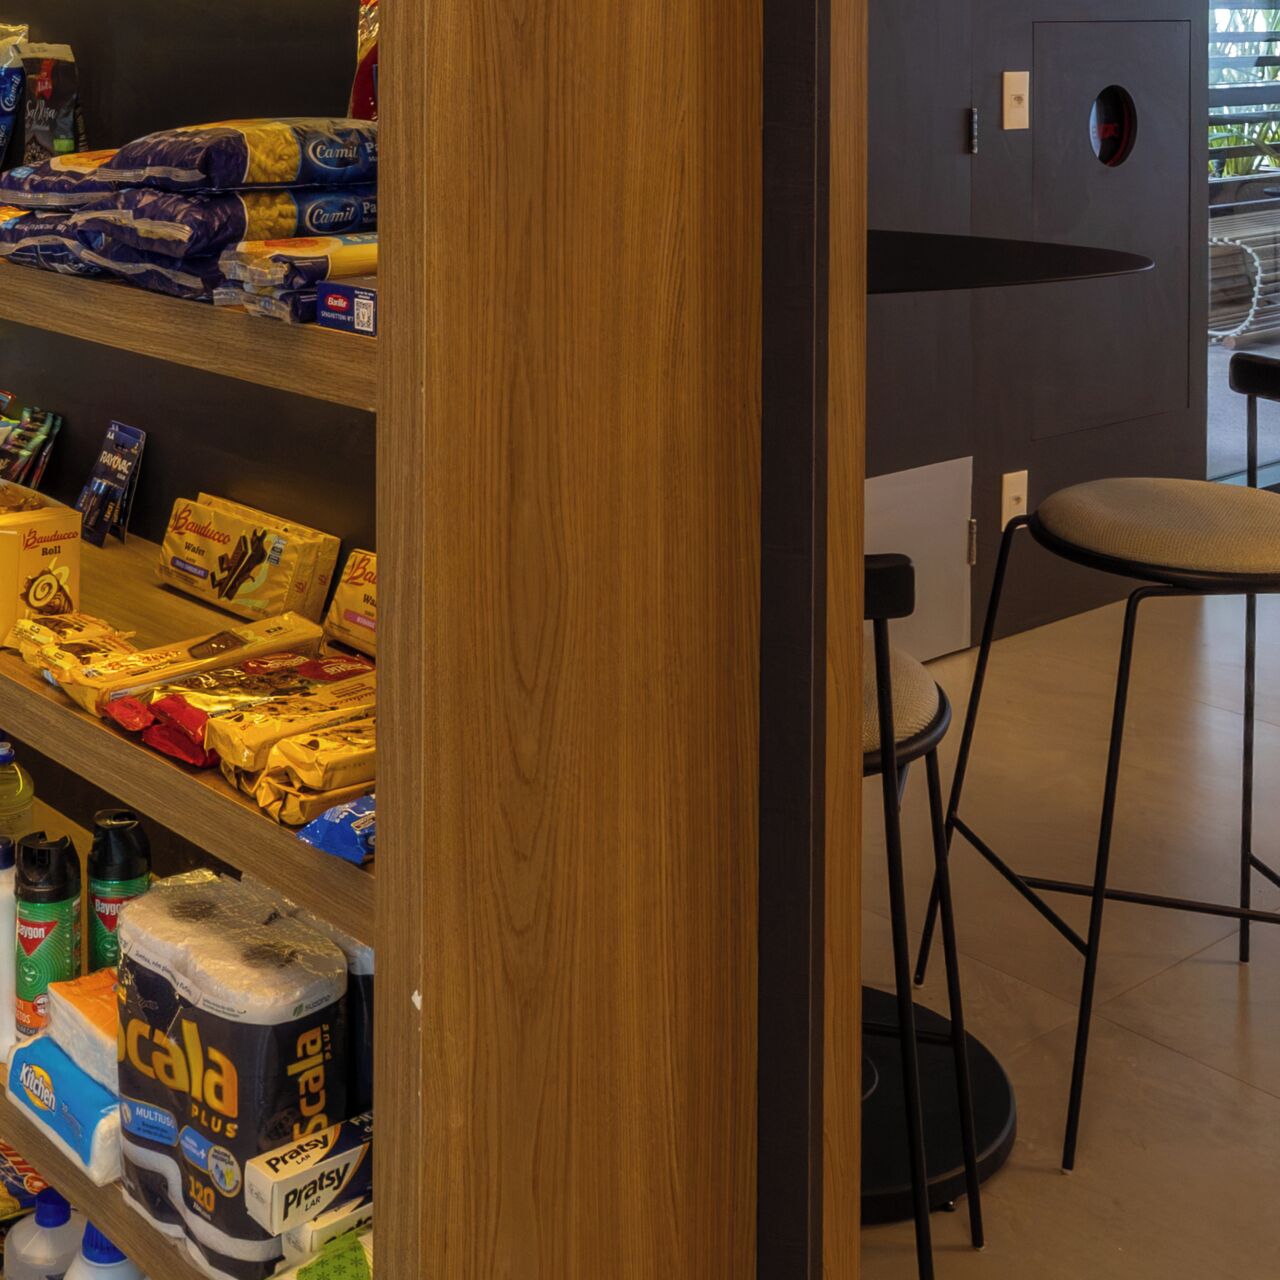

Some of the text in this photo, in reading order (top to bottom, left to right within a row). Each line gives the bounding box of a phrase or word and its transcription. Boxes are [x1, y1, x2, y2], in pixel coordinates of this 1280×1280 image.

[316, 145, 357, 159] Camil
[312, 207, 355, 225] Camil
[99, 450, 132, 474] RAYOVAC
[23, 527, 79, 551] Bauducco
[172, 503, 231, 545] Bauducco
[41, 545, 61, 557] Roll
[20, 1062, 56, 1113] Kitchen
[192, 1103, 239, 1139] PLUS
[265, 1134, 329, 1174] Pratsy
[188, 1174, 216, 1213] 120
[282, 1162, 351, 1222] Pratsy
